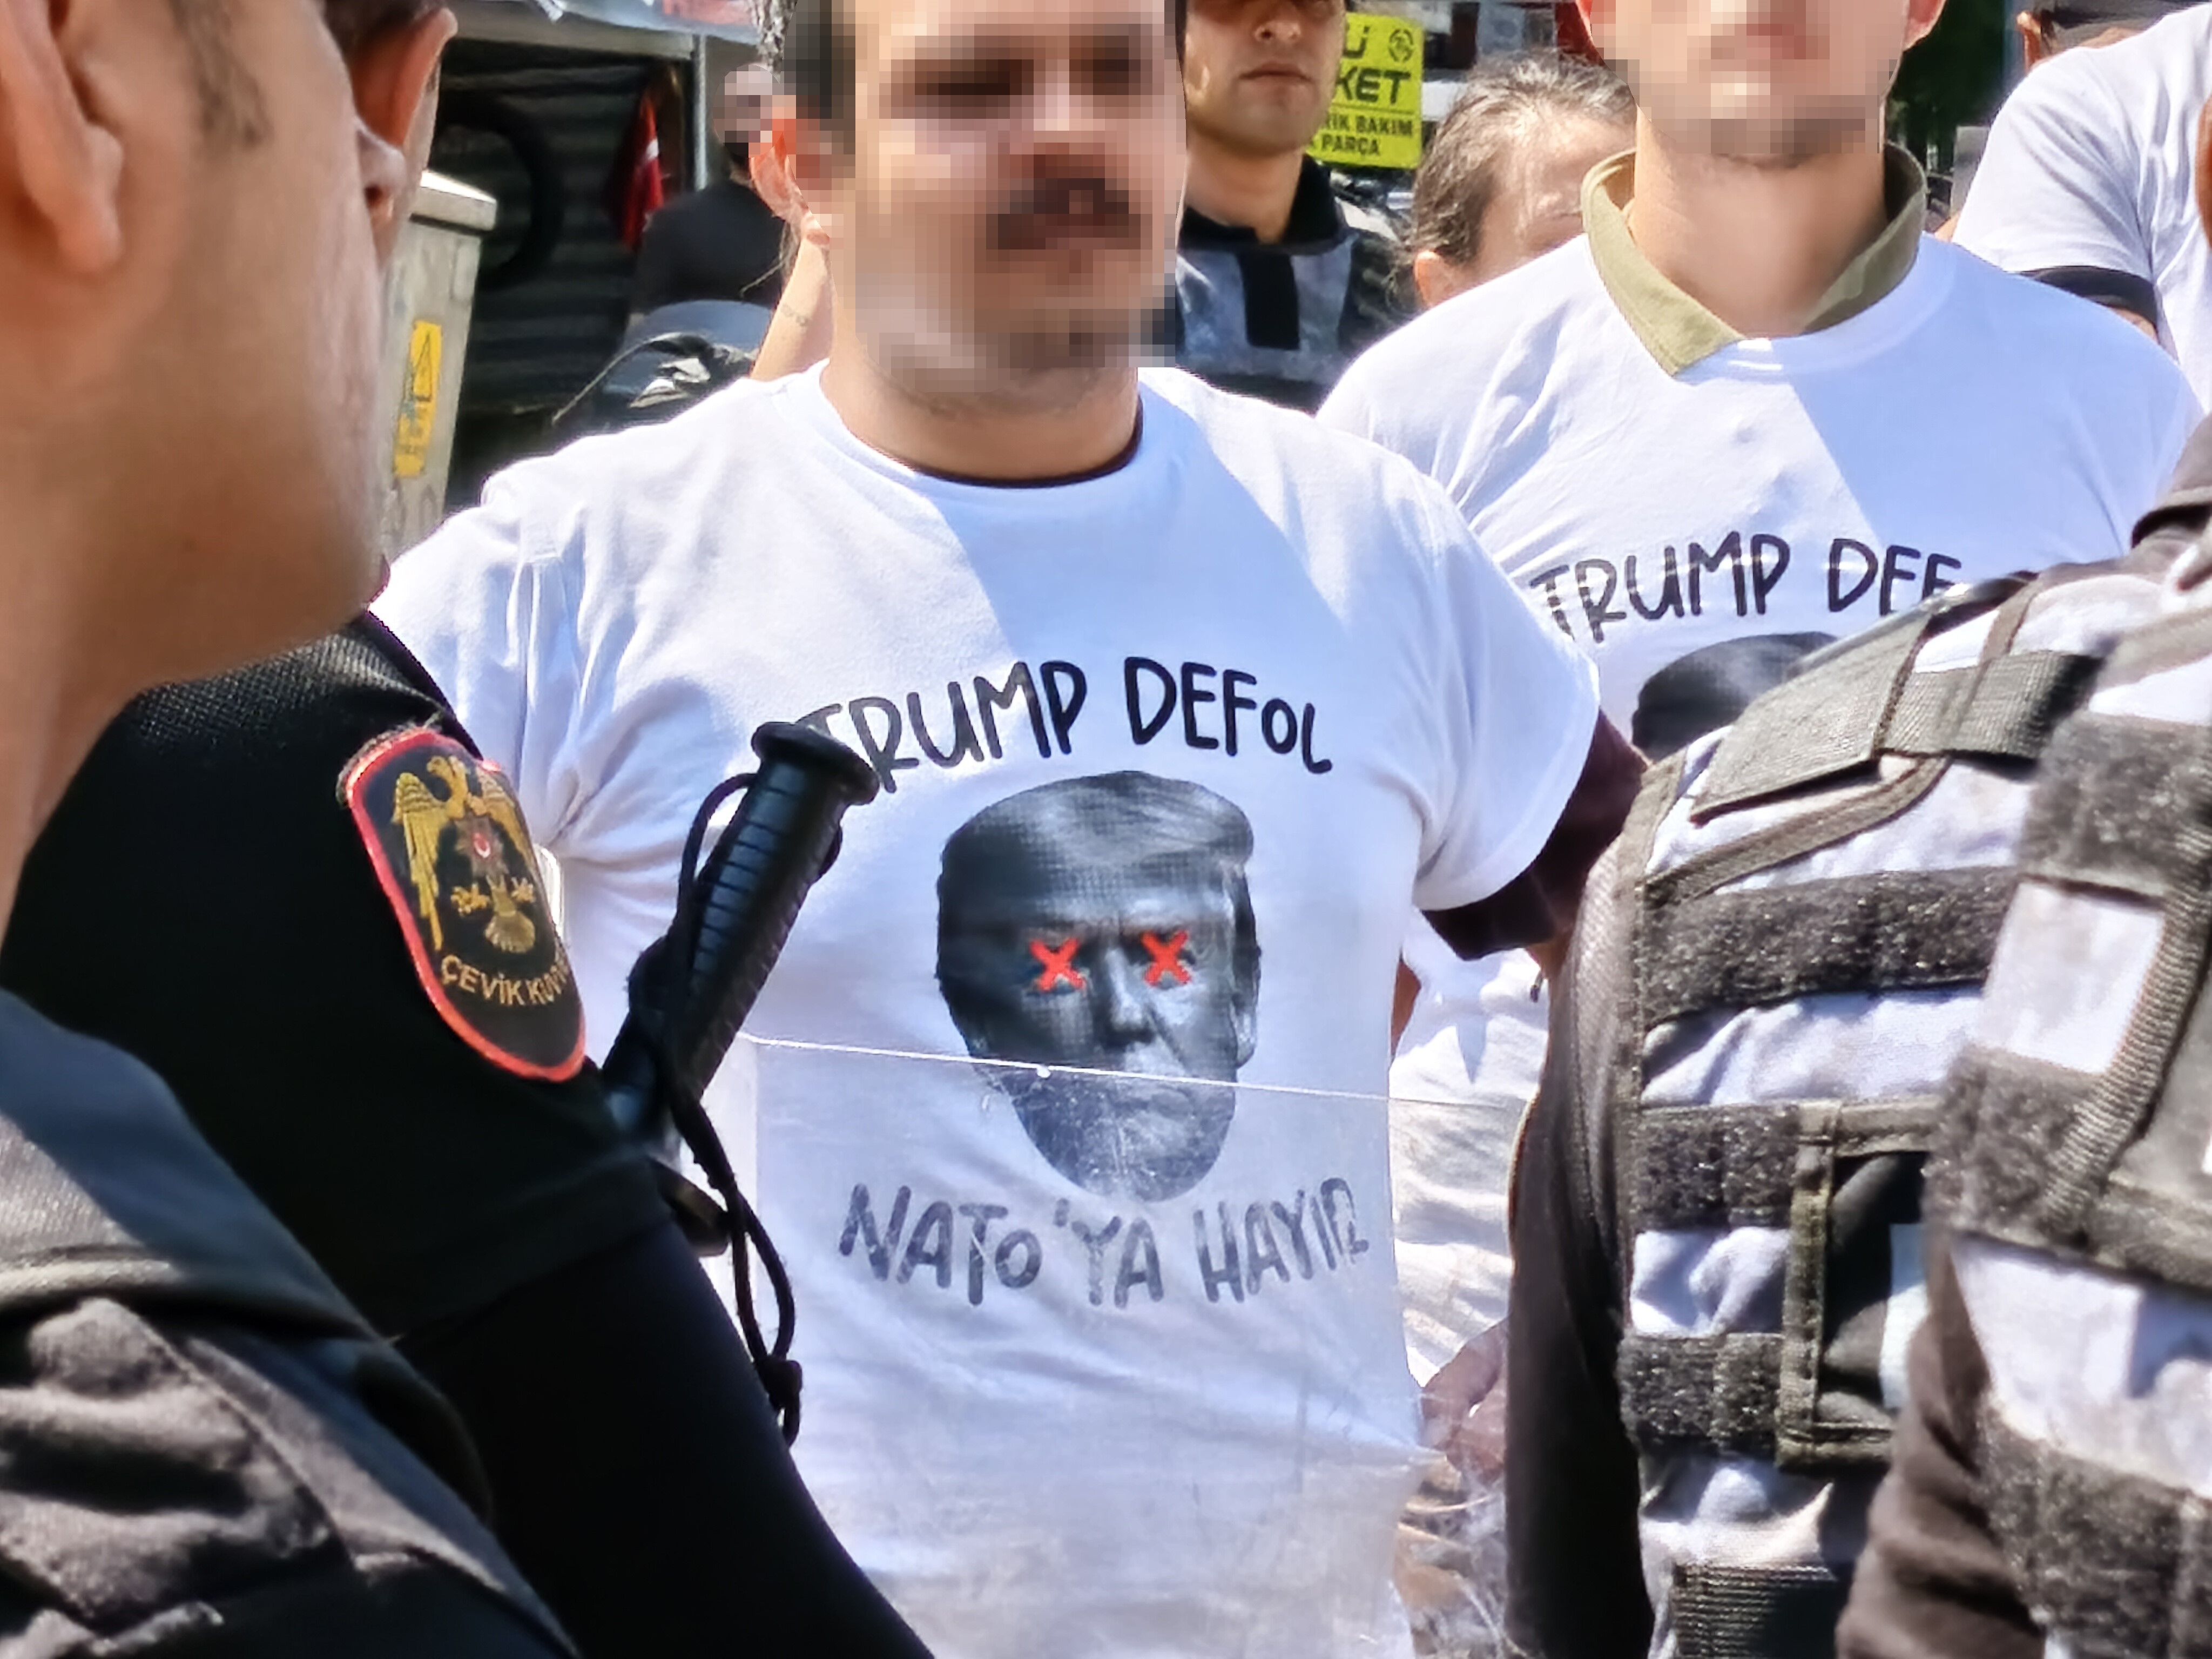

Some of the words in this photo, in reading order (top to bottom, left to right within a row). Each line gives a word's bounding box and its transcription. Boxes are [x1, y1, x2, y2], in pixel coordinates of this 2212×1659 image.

[1321, 134, 1380, 156] PARÇA
[1530, 531, 1790, 643] TRUMP
[1124, 656, 1333, 773] DEFOL
[441, 954, 525, 1006] ÇEVİK
[1193, 1177, 1370, 1303] HAYIR
